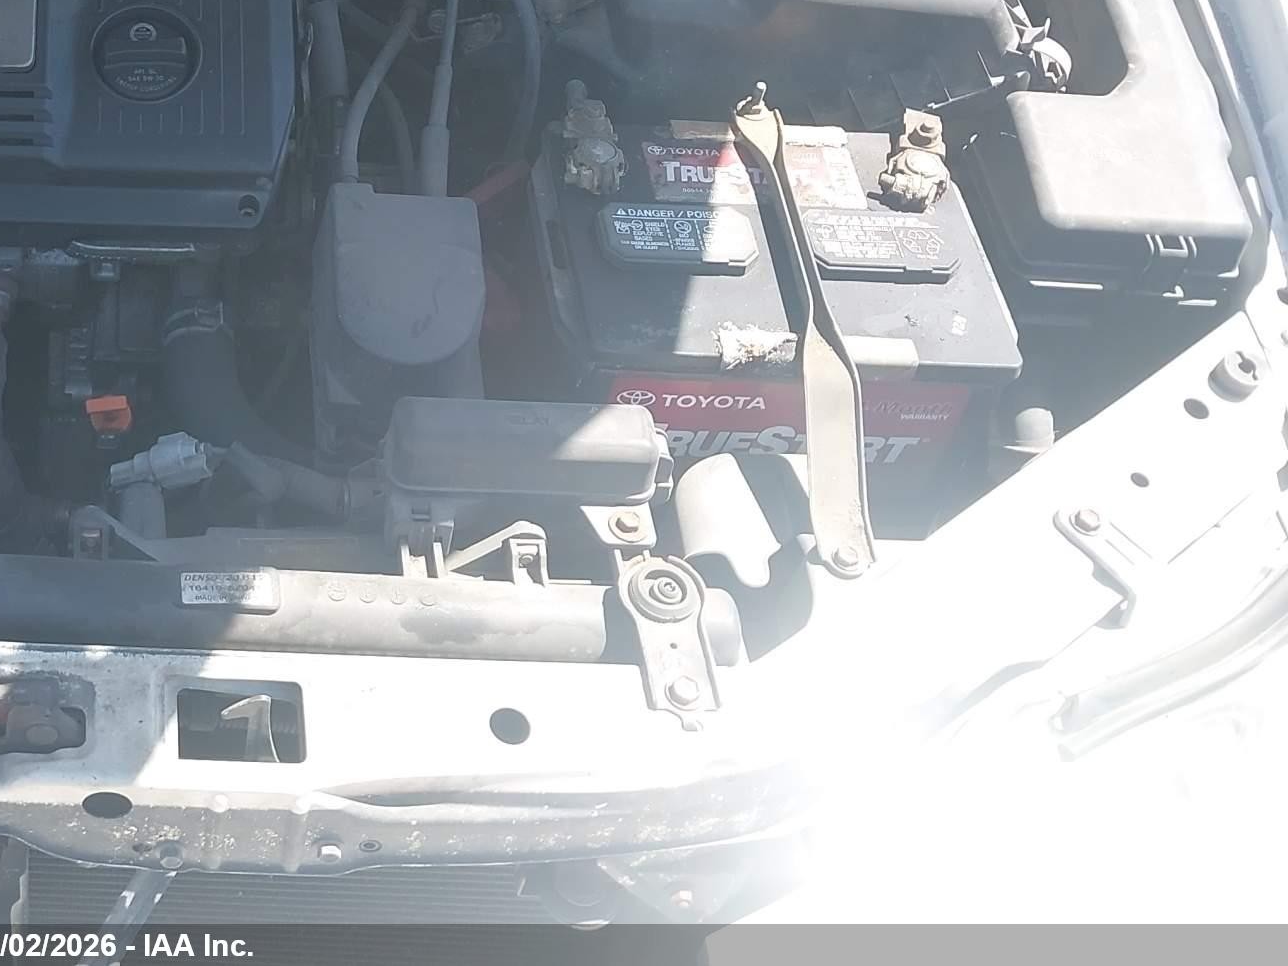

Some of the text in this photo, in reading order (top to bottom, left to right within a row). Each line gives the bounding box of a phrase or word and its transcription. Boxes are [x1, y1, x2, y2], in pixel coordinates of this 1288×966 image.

[668, 147, 721, 157] TOYOTA
[628, 208, 676, 219] DANGER
[677, 209, 684, 219] /
[661, 393, 766, 410] TOYOTA
